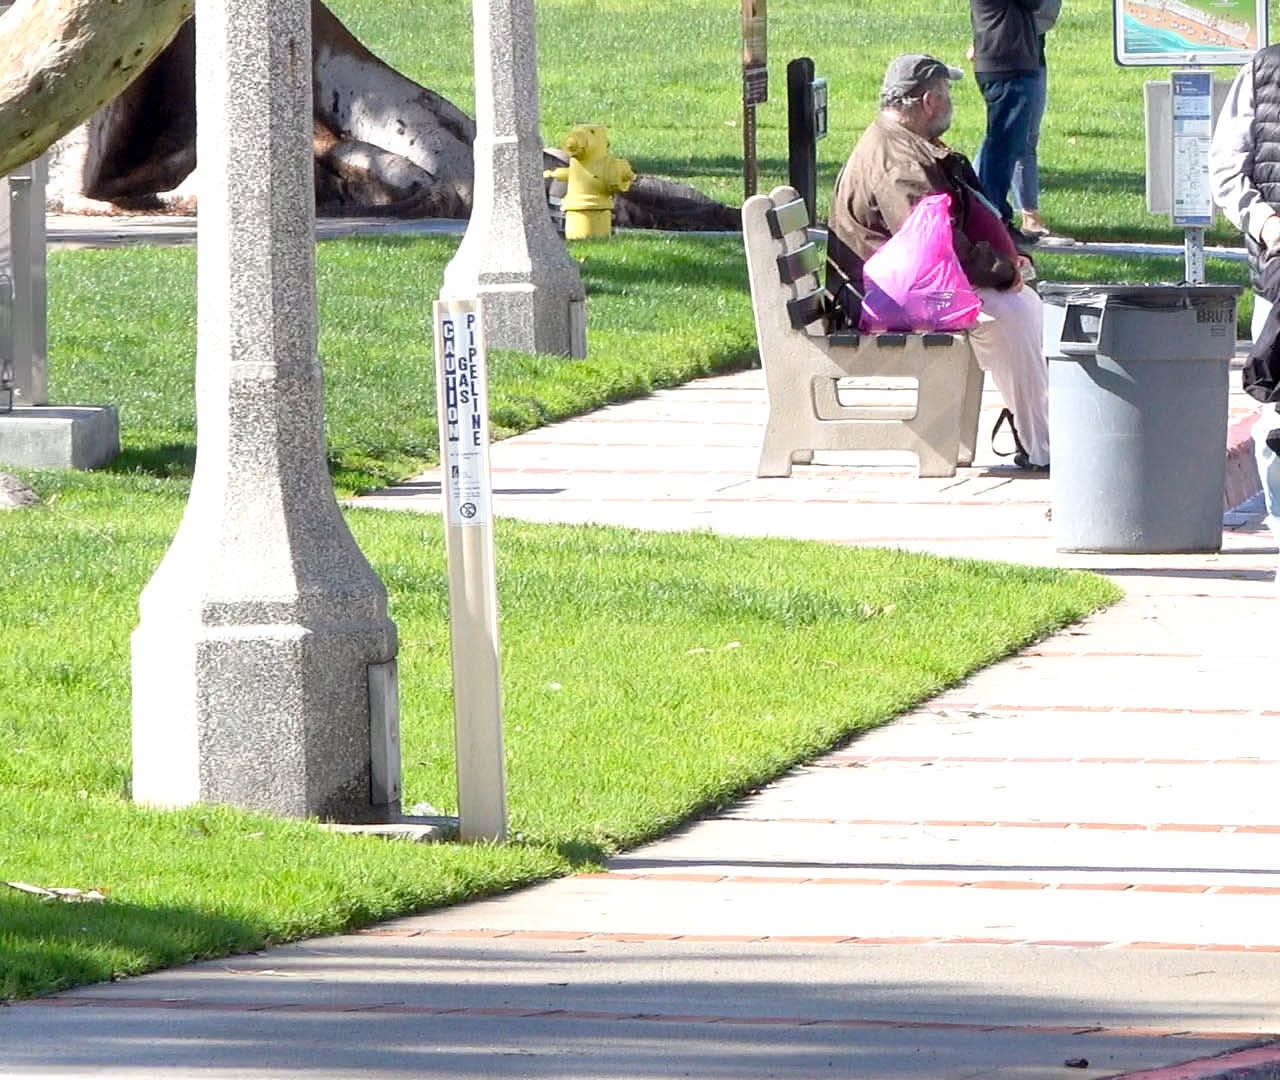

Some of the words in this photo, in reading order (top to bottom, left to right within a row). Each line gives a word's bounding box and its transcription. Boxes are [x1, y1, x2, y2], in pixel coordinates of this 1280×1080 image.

[442, 320, 460, 442] CAUTION
[458, 356, 470, 404] GAS
[466, 313, 481, 446] PIPELINE
